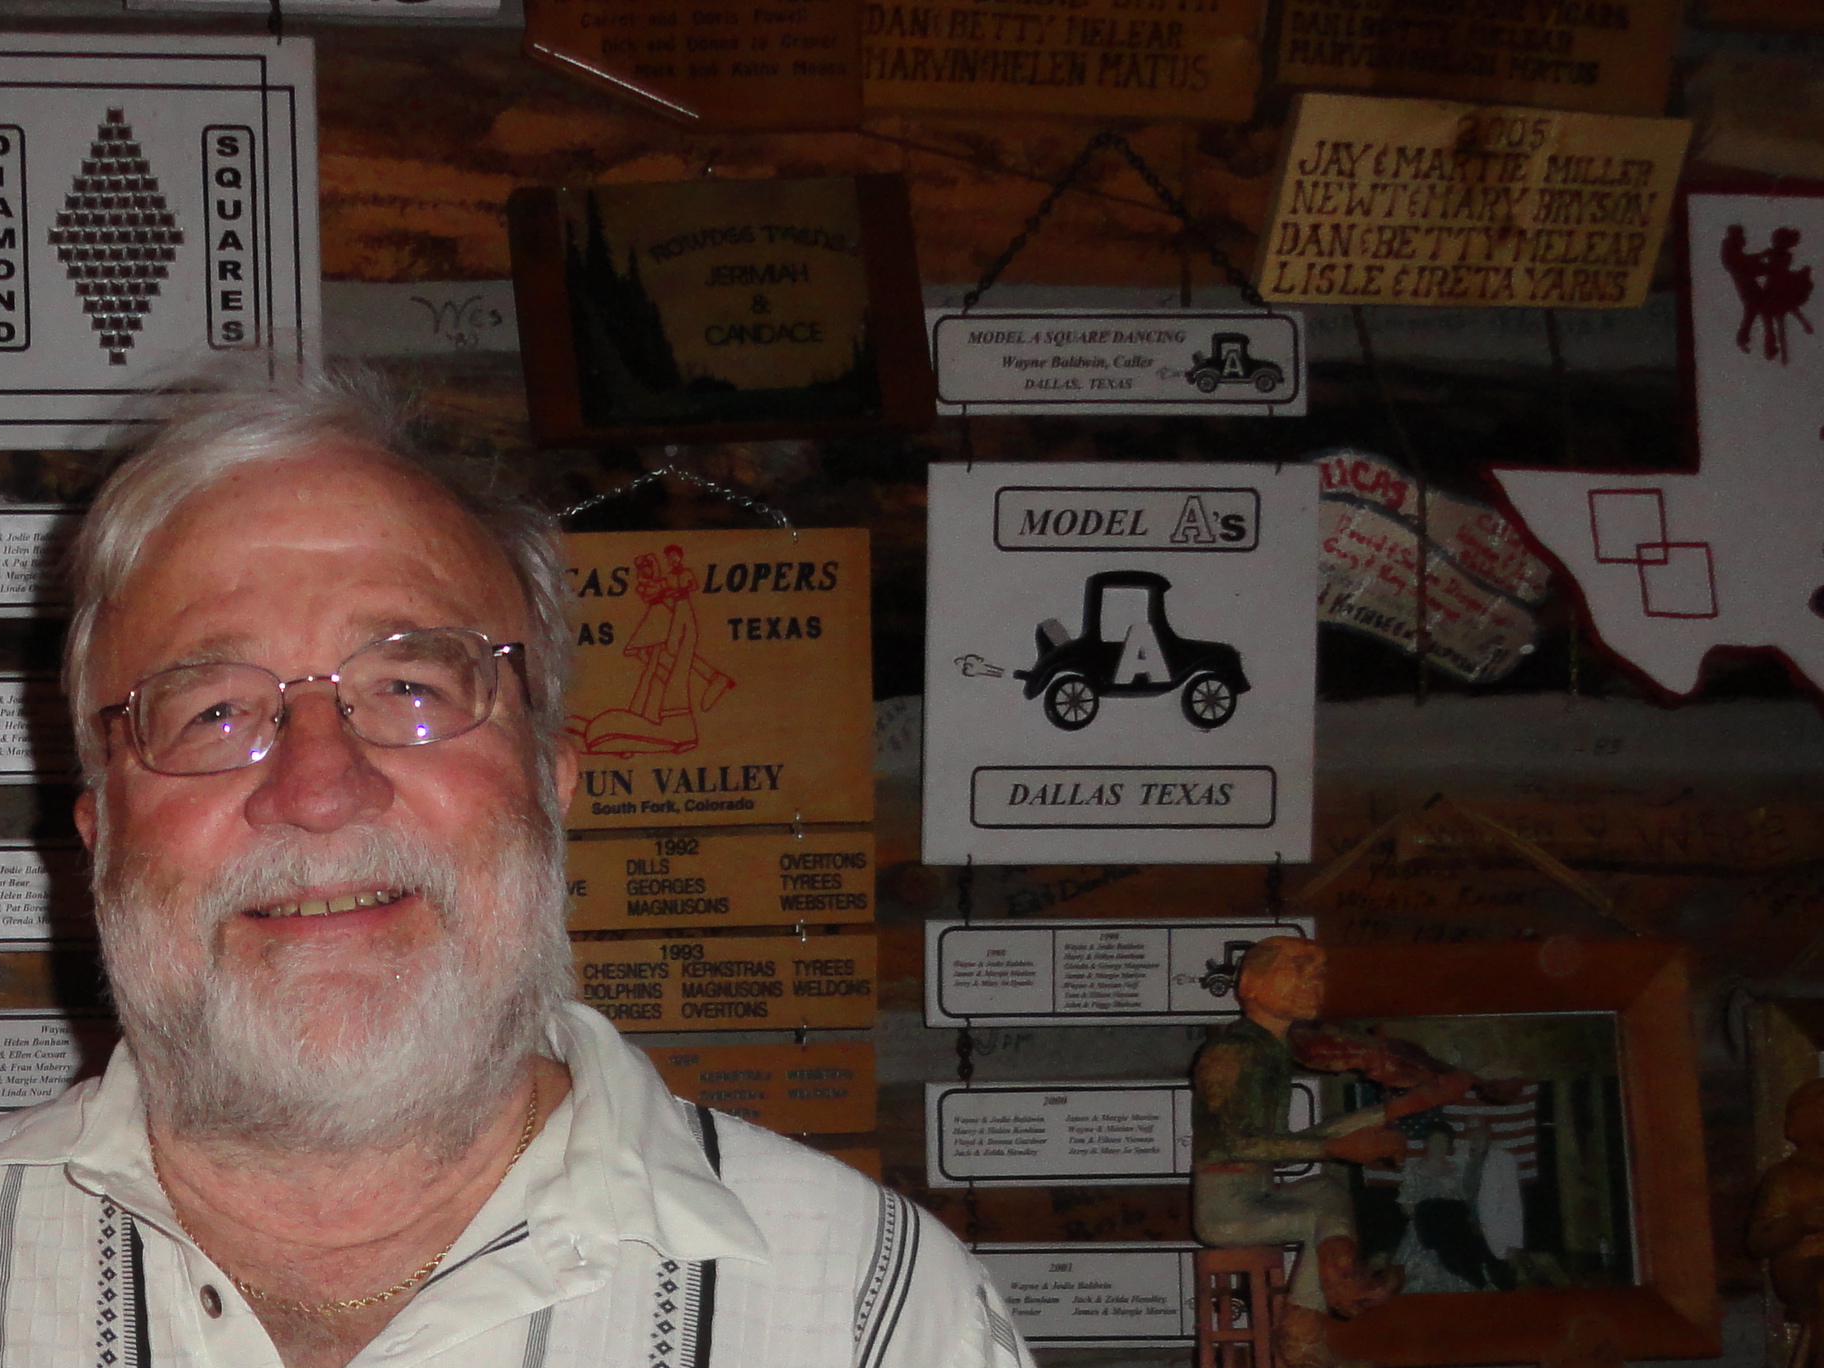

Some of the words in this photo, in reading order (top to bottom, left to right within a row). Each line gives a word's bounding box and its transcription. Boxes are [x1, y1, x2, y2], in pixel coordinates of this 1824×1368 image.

[1544, 155, 1653, 188] MILLER
[215, 135, 244, 342] SQUARES
[1273, 262, 1384, 297] LISLE
[705, 323, 824, 348] CANDACE
[1019, 509, 1149, 537] MODEL
[702, 562, 838, 594] LOPERS
[728, 616, 821, 641] TEXAS
[653, 764, 784, 796] VALLEY
[1008, 783, 1124, 806] DALLAS
[1139, 783, 1233, 805] TEXAS
[592, 801, 636, 816] South
[685, 797, 754, 812] Colorado
[654, 839, 699, 857] 1992
[627, 859, 669, 876] DILLS
[779, 853, 866, 871] OVERTONS
[627, 878, 706, 895] GEORGES
[779, 873, 842, 890] TYREES
[627, 896, 730, 916] MAGNUSONS
[780, 893, 867, 911] WEBSTERS
[660, 944, 704, 960] 1993
[583, 962, 668, 980] CHESNEYS
[681, 961, 775, 978] KERKSTRAS
[793, 959, 854, 977] TYREES
[583, 983, 663, 1000] DOLPHINS
[681, 980, 784, 999] MAGNUSONS
[792, 979, 871, 996] WELDONS
[681, 1002, 768, 1019] OVERTONS
